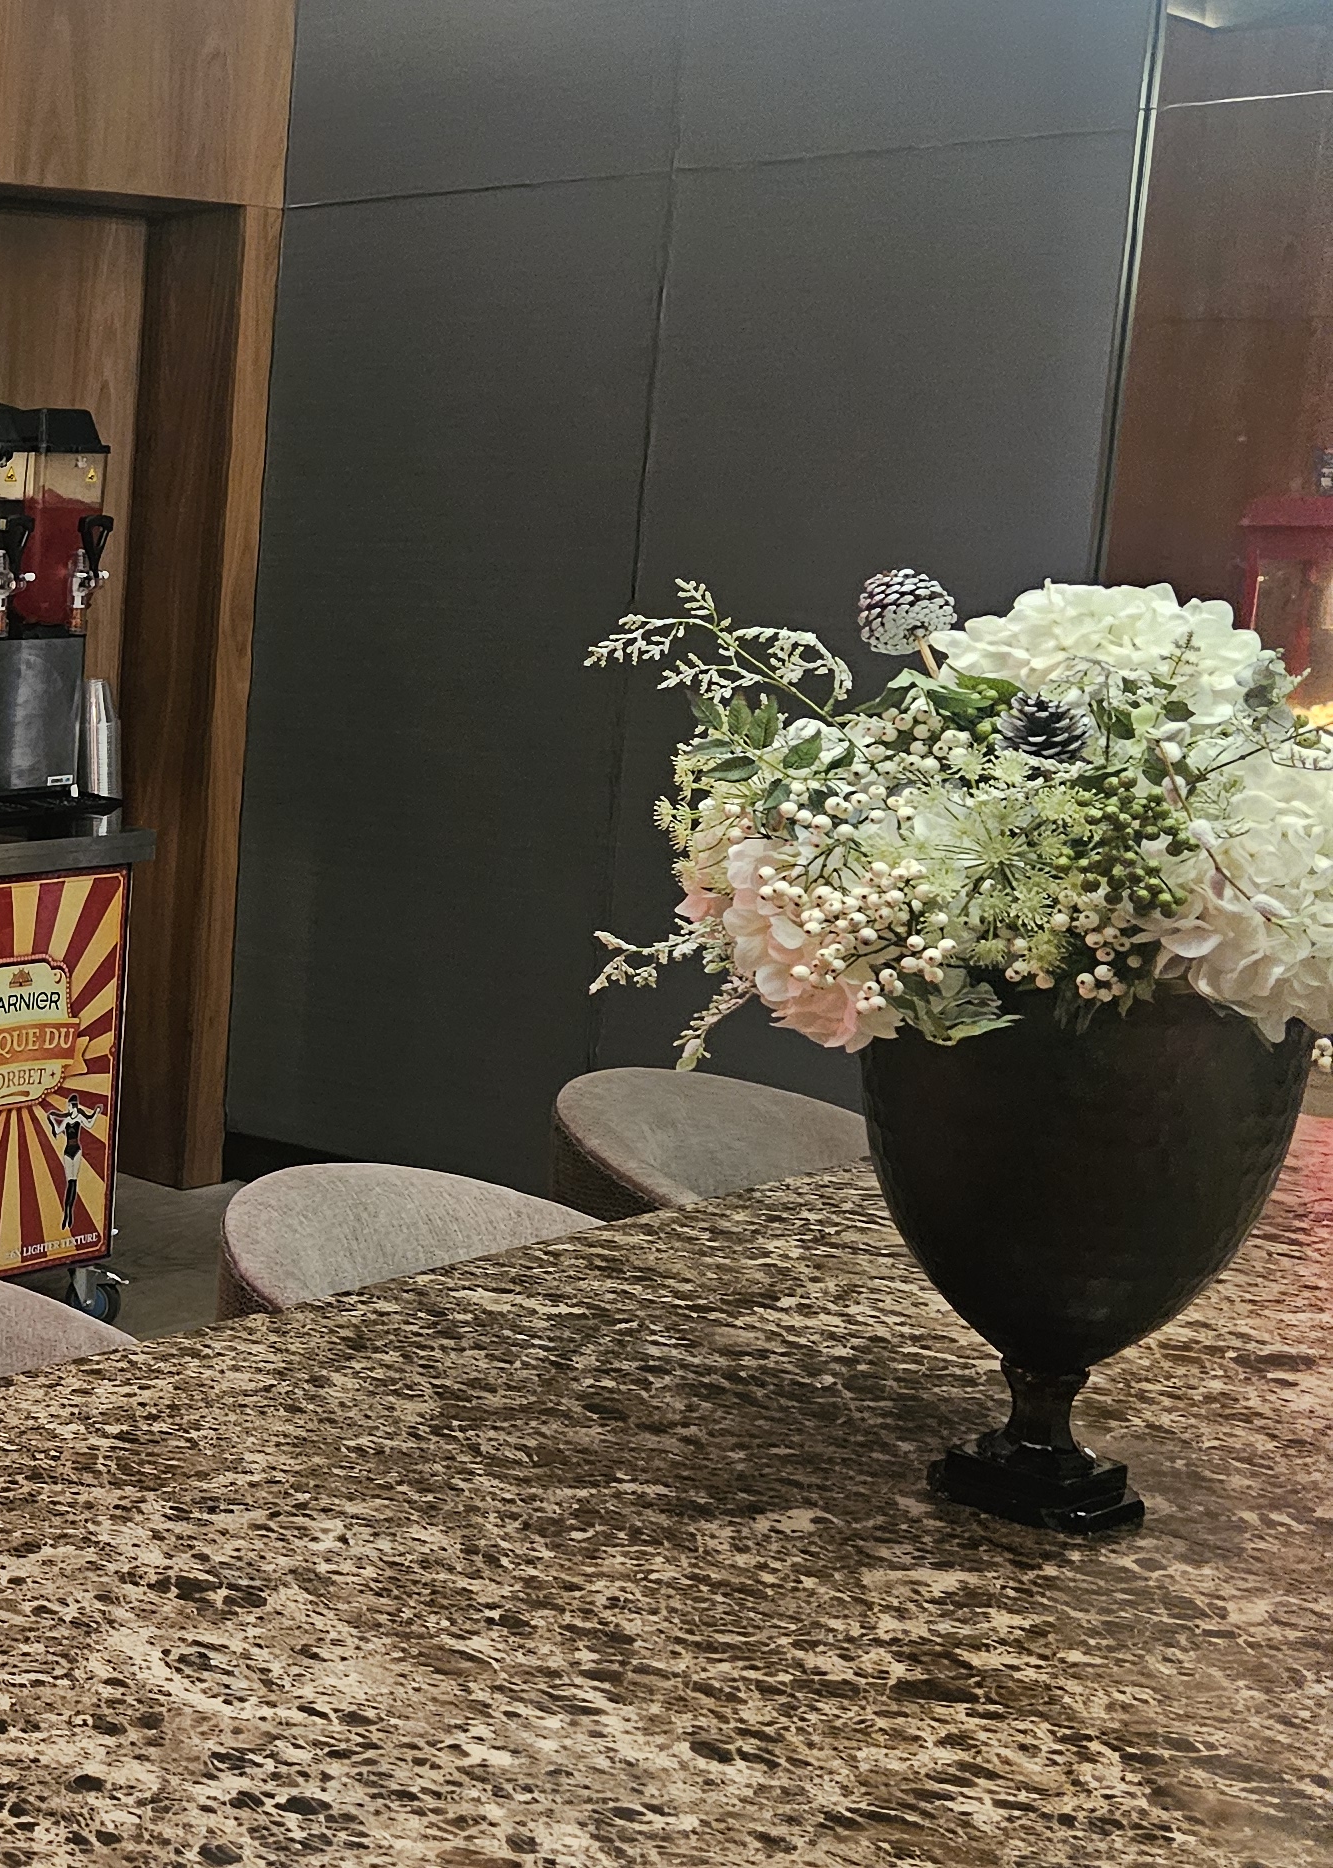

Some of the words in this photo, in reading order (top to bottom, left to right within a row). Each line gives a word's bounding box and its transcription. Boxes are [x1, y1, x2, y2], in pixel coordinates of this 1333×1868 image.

[44, 1028, 75, 1049] DU
[23, 1240, 60, 1257] LIGHTER
[61, 1232, 98, 1249] TEXTURE
